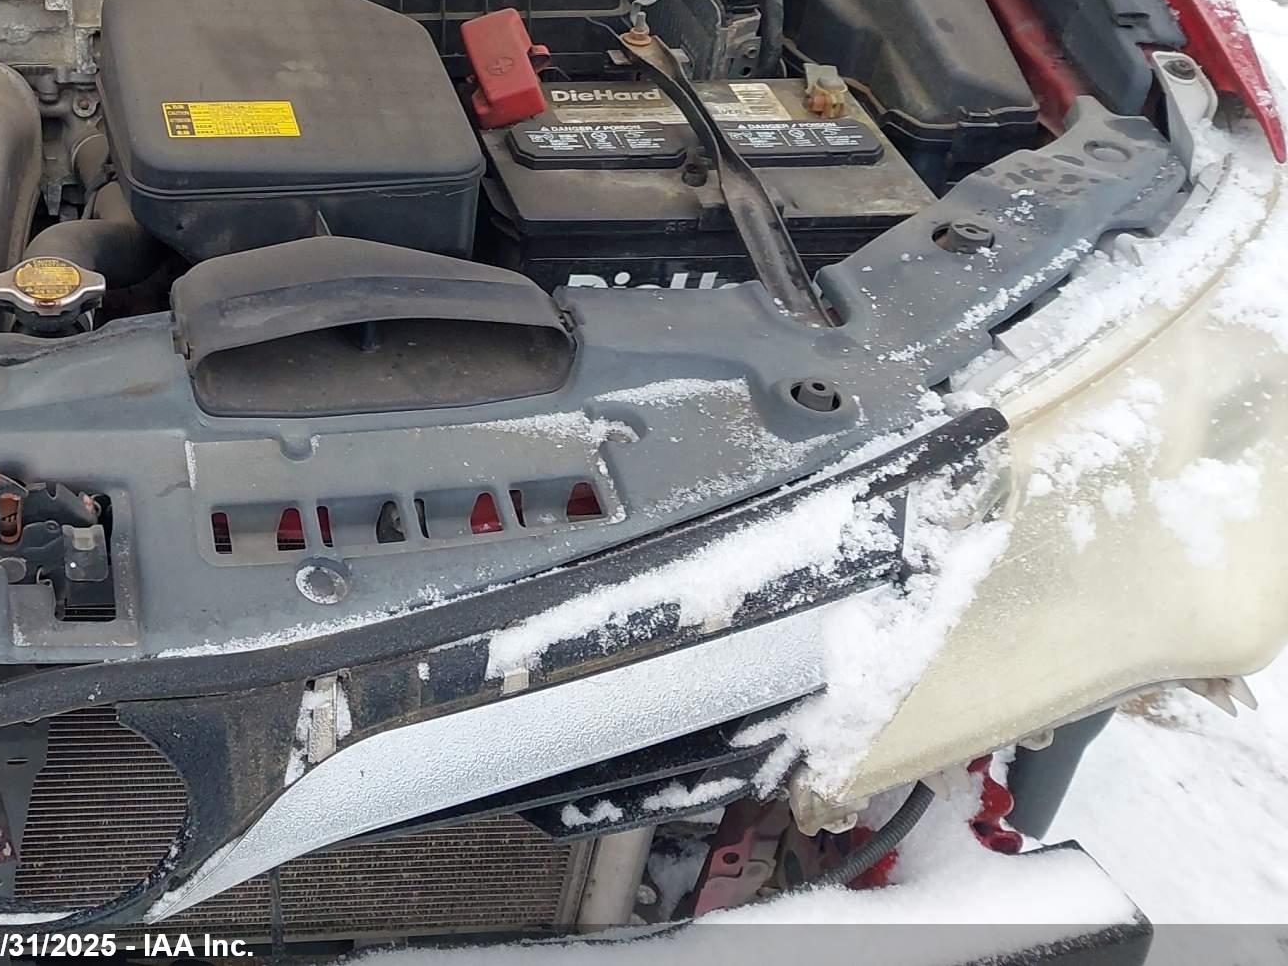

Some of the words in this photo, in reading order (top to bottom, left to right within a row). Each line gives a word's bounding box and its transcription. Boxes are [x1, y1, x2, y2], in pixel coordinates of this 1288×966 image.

[550, 88, 662, 102] DieHard
[747, 122, 789, 130] DANGER
[797, 121, 838, 129] POISON
